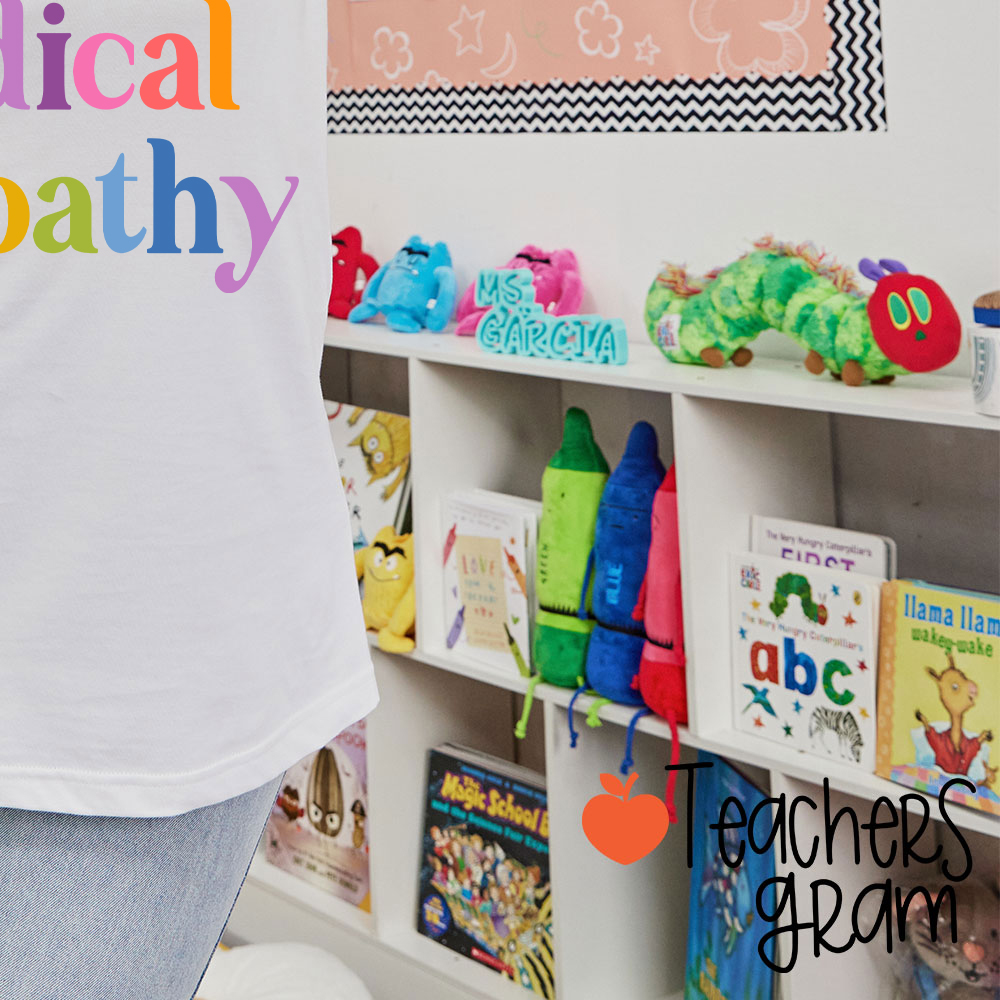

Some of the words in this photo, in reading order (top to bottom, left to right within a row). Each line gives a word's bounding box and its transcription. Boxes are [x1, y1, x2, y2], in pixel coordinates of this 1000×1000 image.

[904, 593, 955, 627] llama
[960, 605, 1000, 637] llam
[750, 636, 856, 706] abc
[486, 788, 540, 832] School
